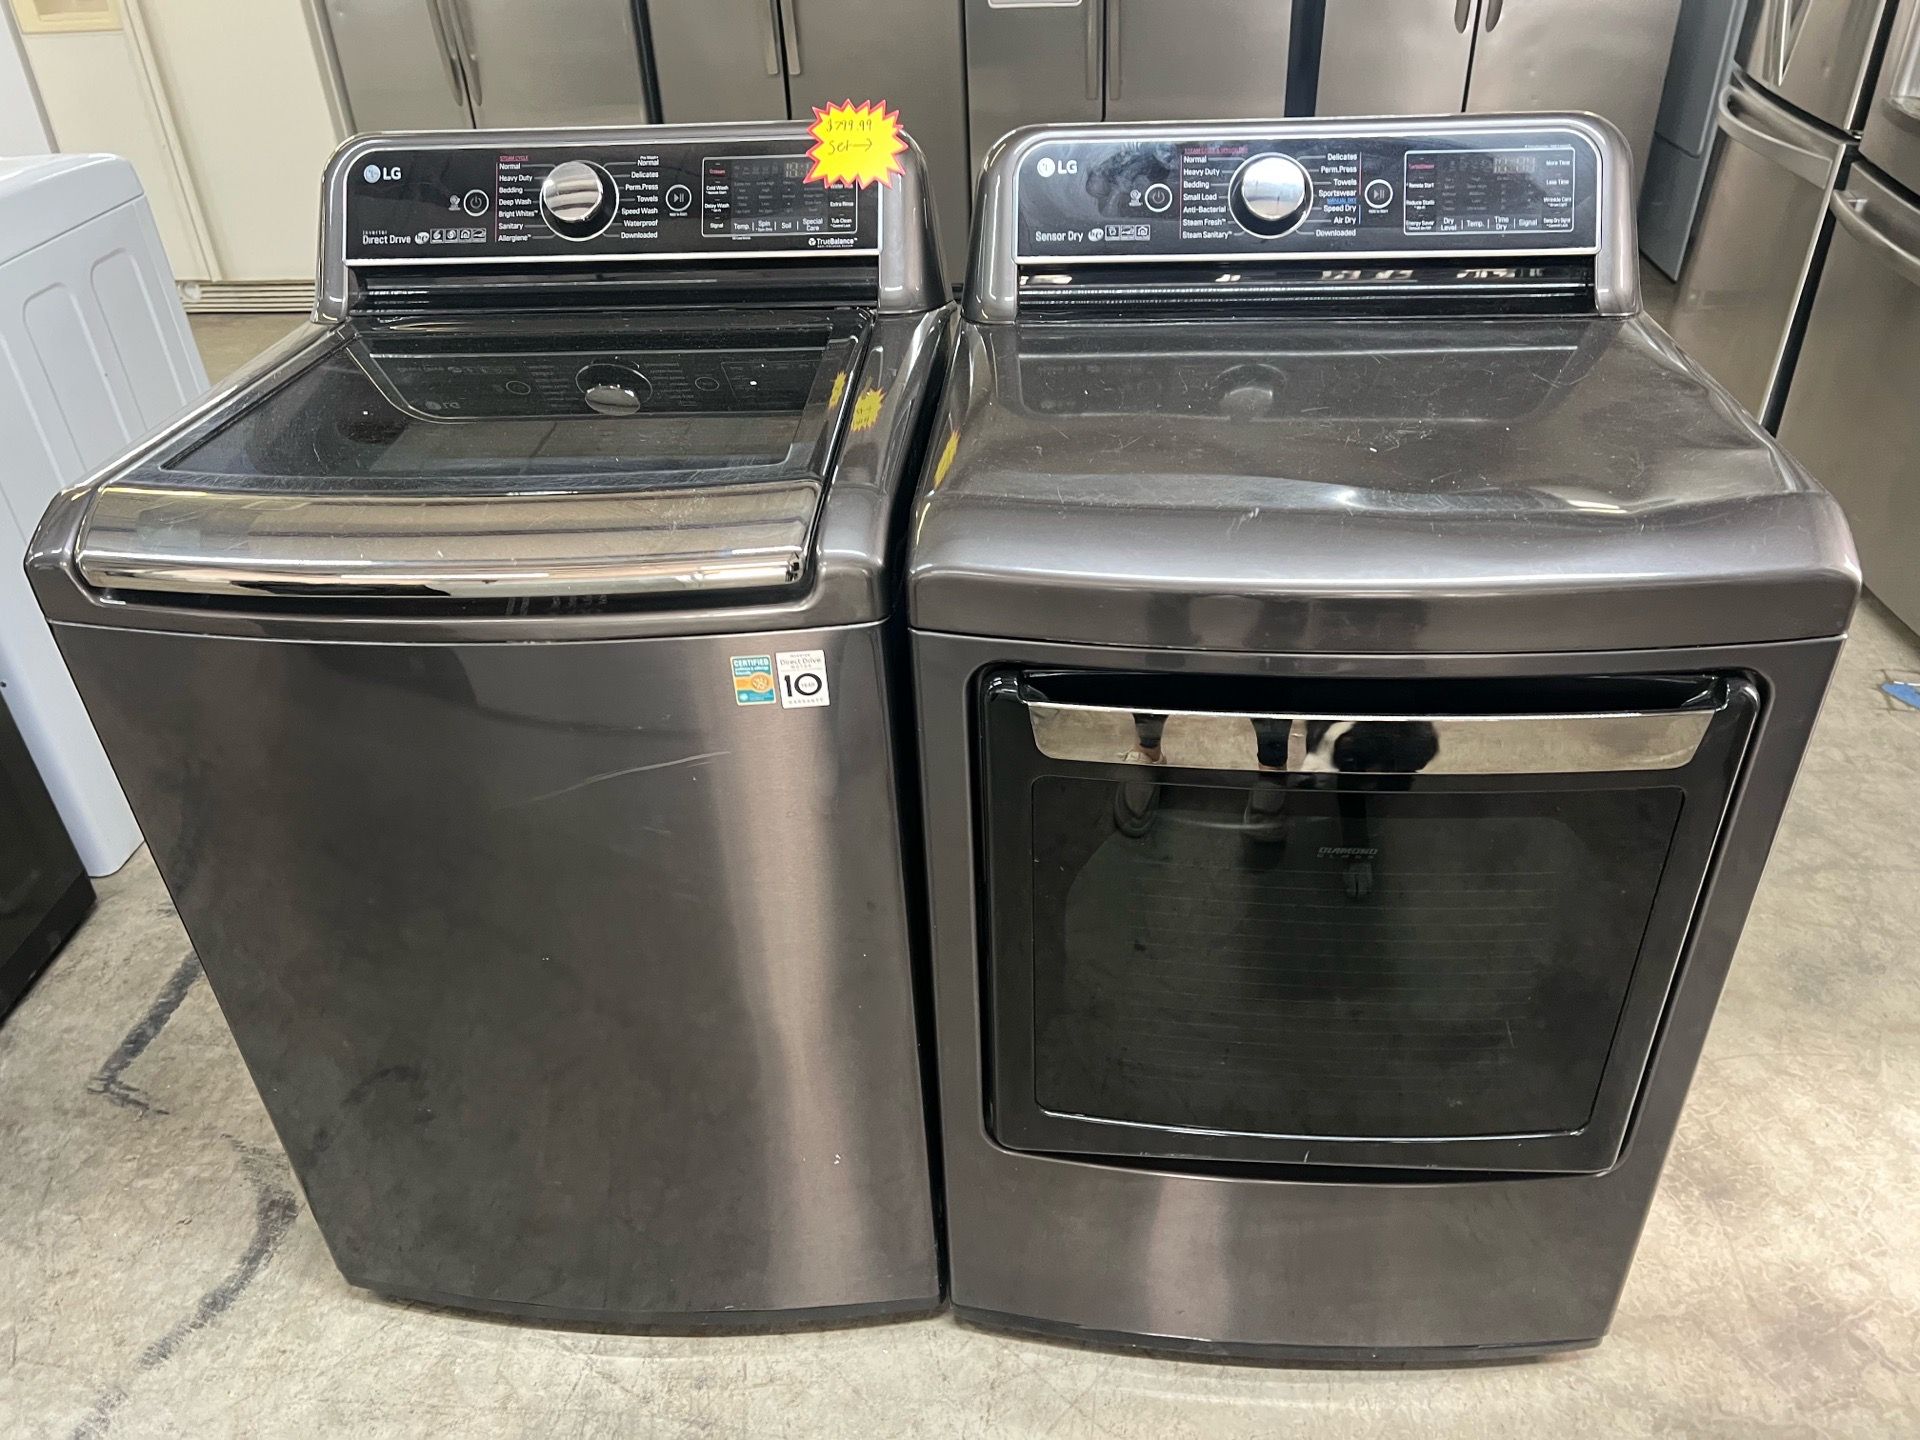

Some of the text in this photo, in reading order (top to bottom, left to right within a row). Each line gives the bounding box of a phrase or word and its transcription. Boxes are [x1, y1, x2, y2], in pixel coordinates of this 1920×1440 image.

[1184, 155, 1207, 163] Normal
[1058, 160, 1078, 174] LG
[383, 167, 402, 180] LG
[1205, 168, 1220, 176] Duty
[518, 174, 532, 182] Duty
[1333, 178, 1357, 186] Towels
[1184, 181, 1209, 189] Bedding
[1319, 190, 1356, 198] Sportswear
[624, 219, 658, 227] Waterproof
[1345, 216, 1356, 225] Dry
[1519, 219, 1537, 227] Signal
[1036, 231, 1066, 241] Sensor
[1068, 231, 1083, 242] Dry
[1183, 231, 1202, 239] Steam
[1316, 229, 1356, 237] Downloaded
[362, 235, 388, 245] Direct
[389, 235, 412, 244] Drive
[734, 658, 769, 667] CERTIFIED
[784, 673, 822, 697] 10
